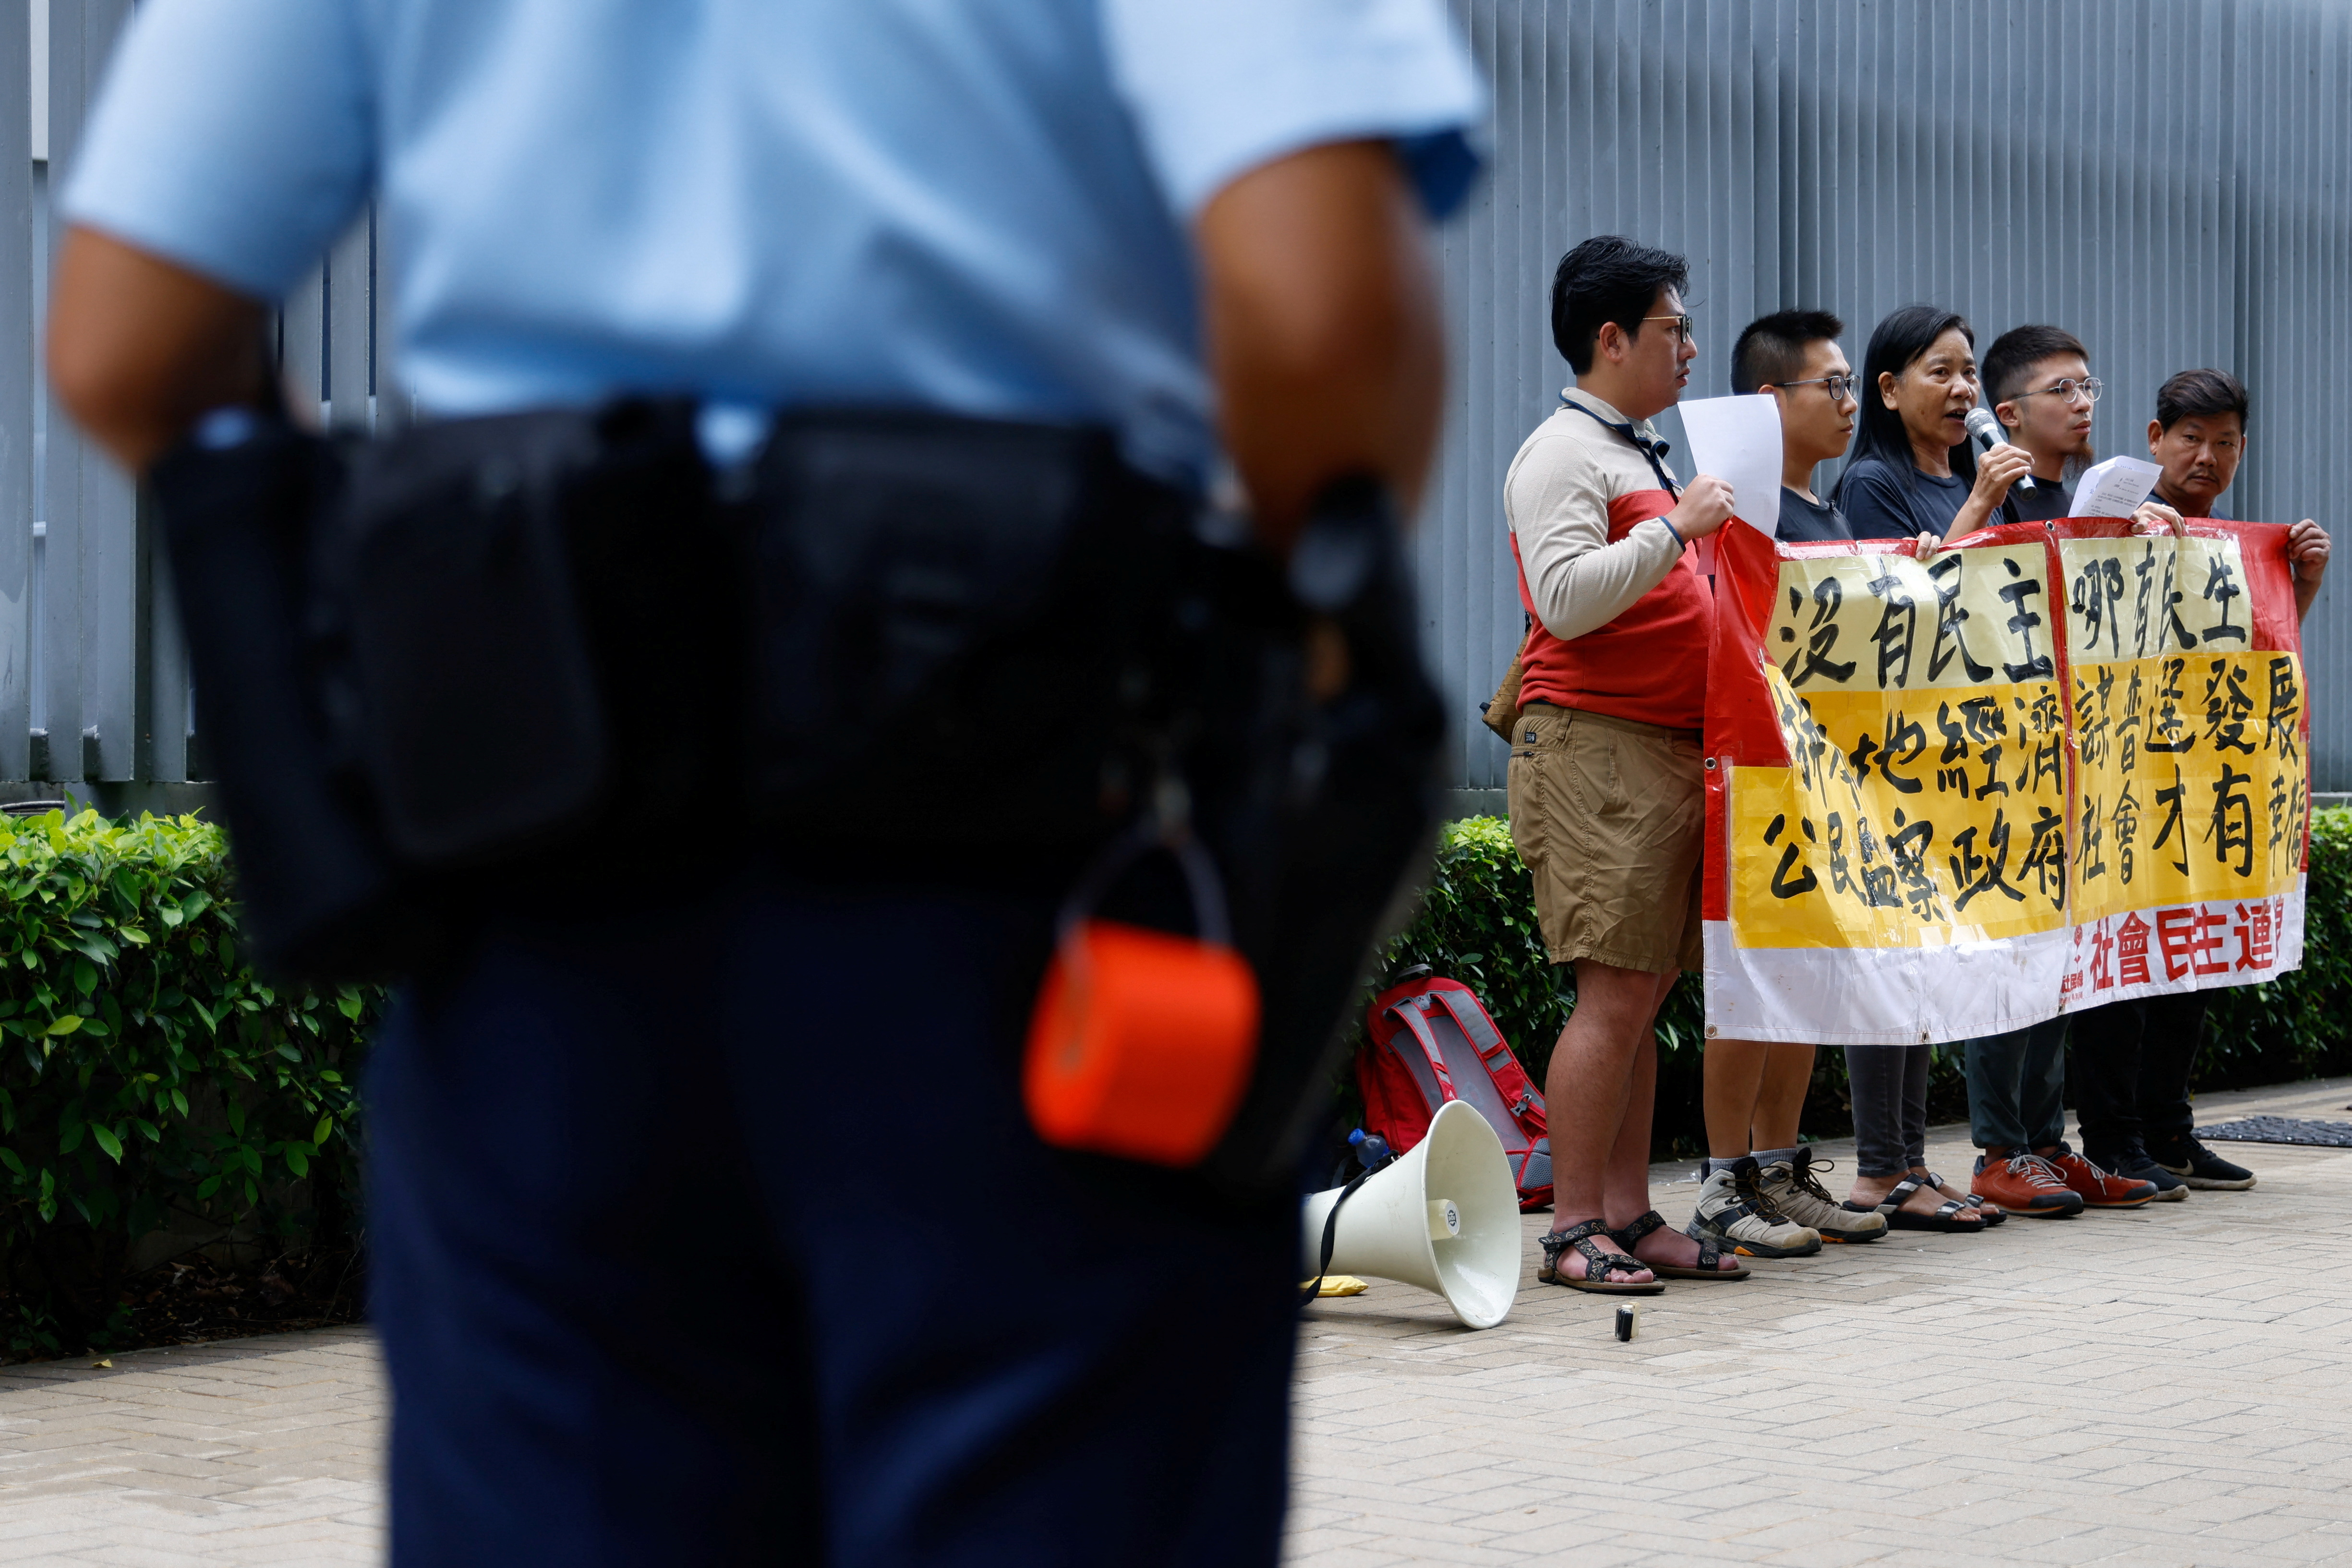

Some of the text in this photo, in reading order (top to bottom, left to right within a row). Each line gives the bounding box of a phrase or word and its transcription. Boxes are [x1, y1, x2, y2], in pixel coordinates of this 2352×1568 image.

[2075, 655, 2298, 774] 謀普選發展
[1763, 806, 2067, 922] 公民監察政府
[2090, 896, 2284, 993] 社會民主連
